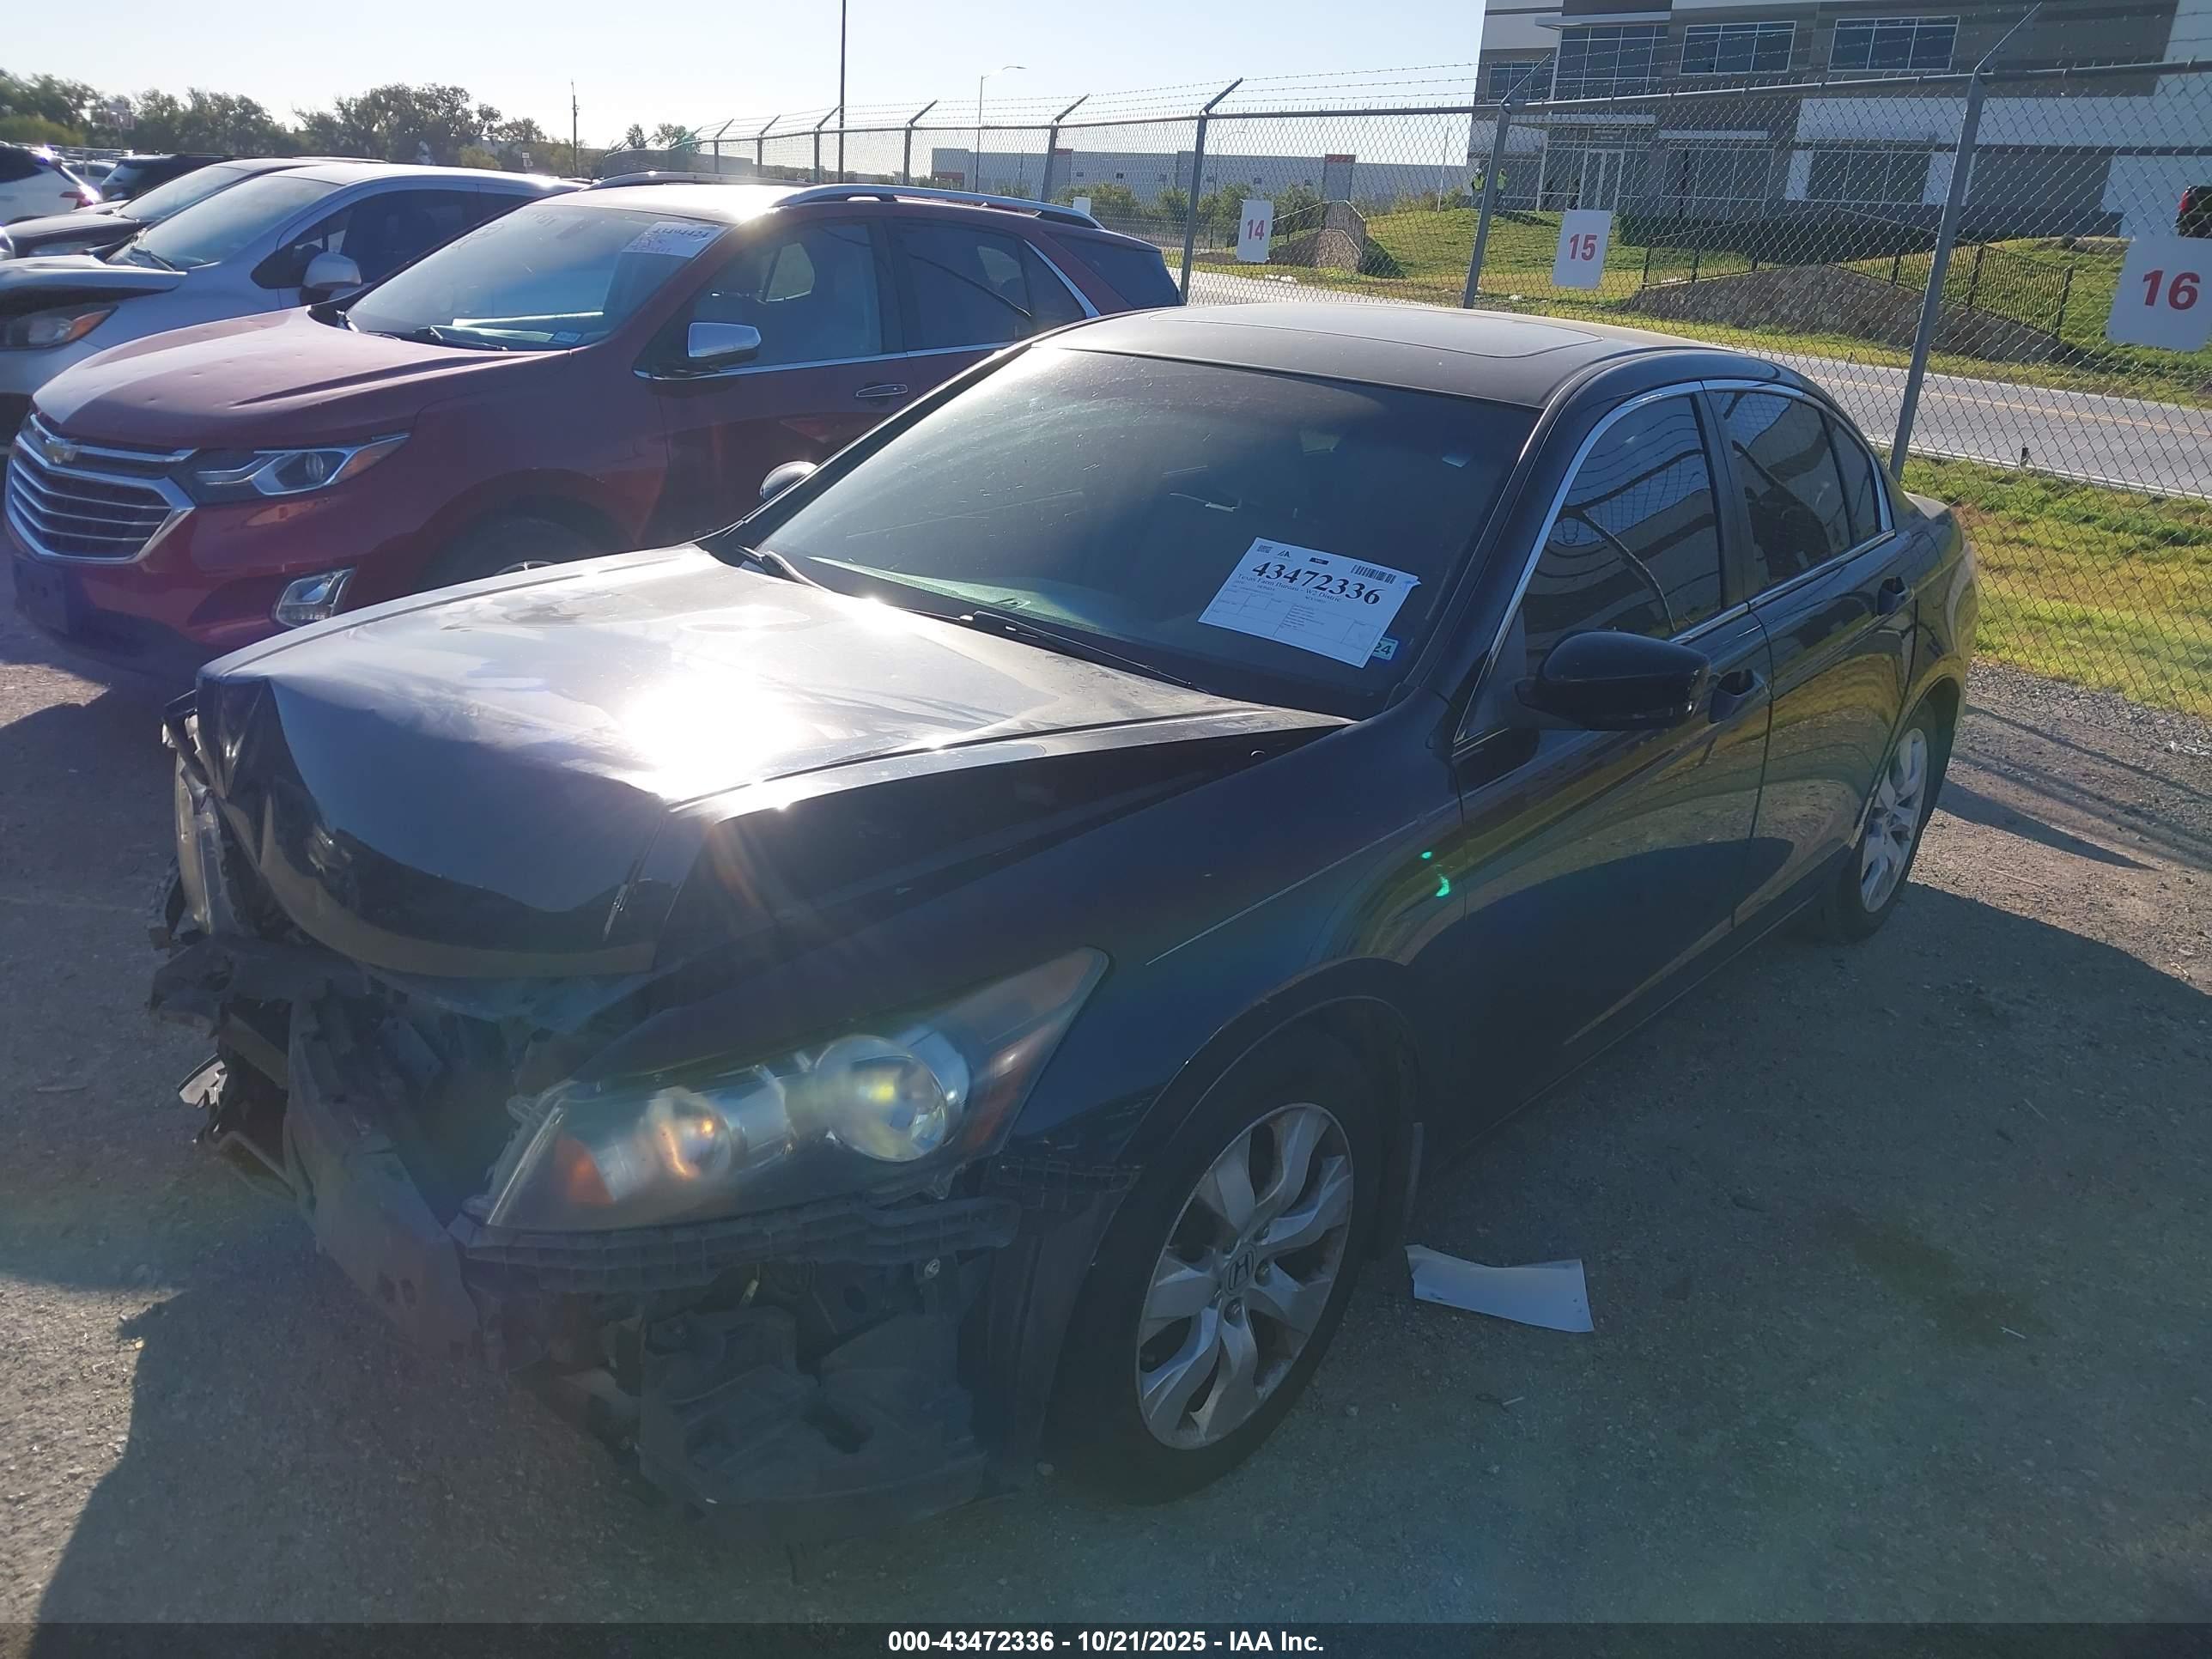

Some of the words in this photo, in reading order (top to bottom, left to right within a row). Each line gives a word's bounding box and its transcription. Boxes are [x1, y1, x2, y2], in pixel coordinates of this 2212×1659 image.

[1247, 219, 1265, 240] 14
[1570, 234, 1597, 261] 15
[2142, 270, 2201, 311] 16
[1251, 561, 1387, 605] 43472336
